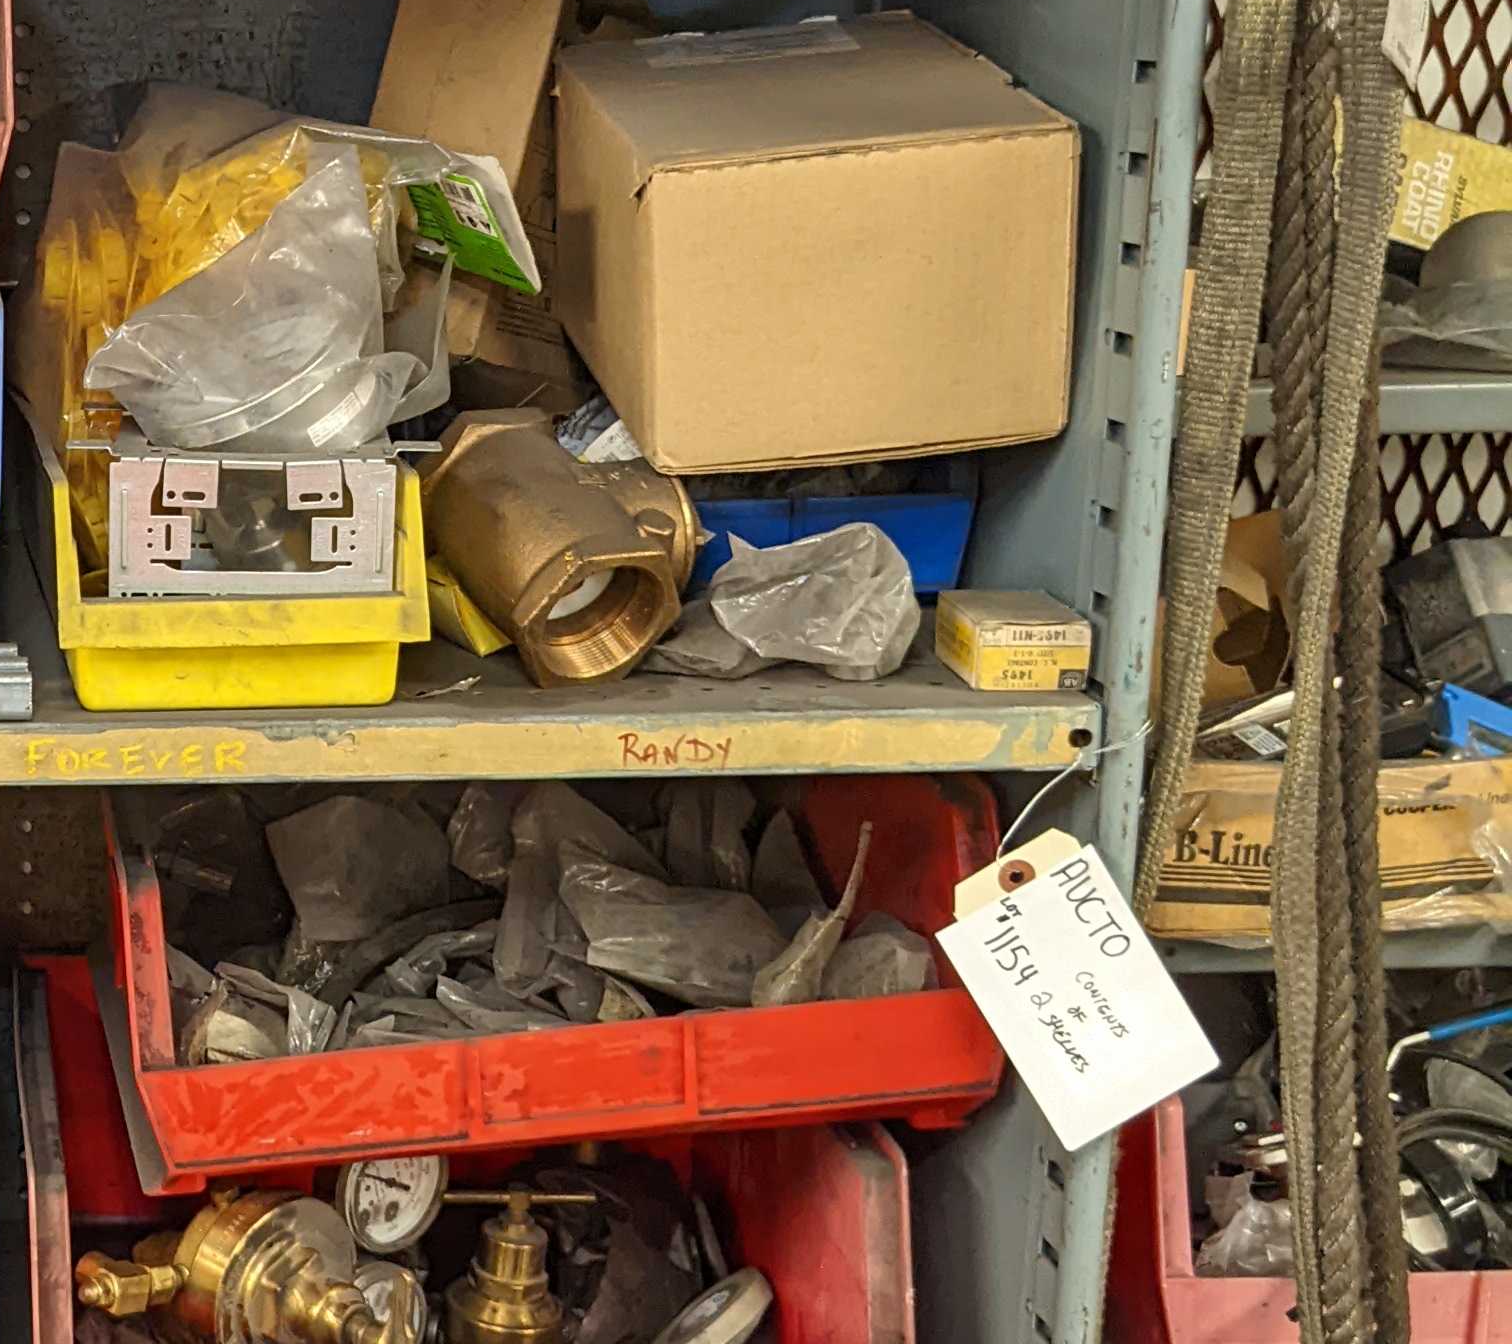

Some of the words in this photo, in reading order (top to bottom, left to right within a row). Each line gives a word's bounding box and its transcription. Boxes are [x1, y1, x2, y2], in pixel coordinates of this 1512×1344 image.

[1401, 159, 1432, 236] COAT
[1417, 149, 1455, 244] RHINO
[25, 738, 247, 776] FOREVER
[617, 731, 734, 768] RANDY
[999, 896, 1023, 920] LOT
[1050, 858, 1131, 958] AUCTO
